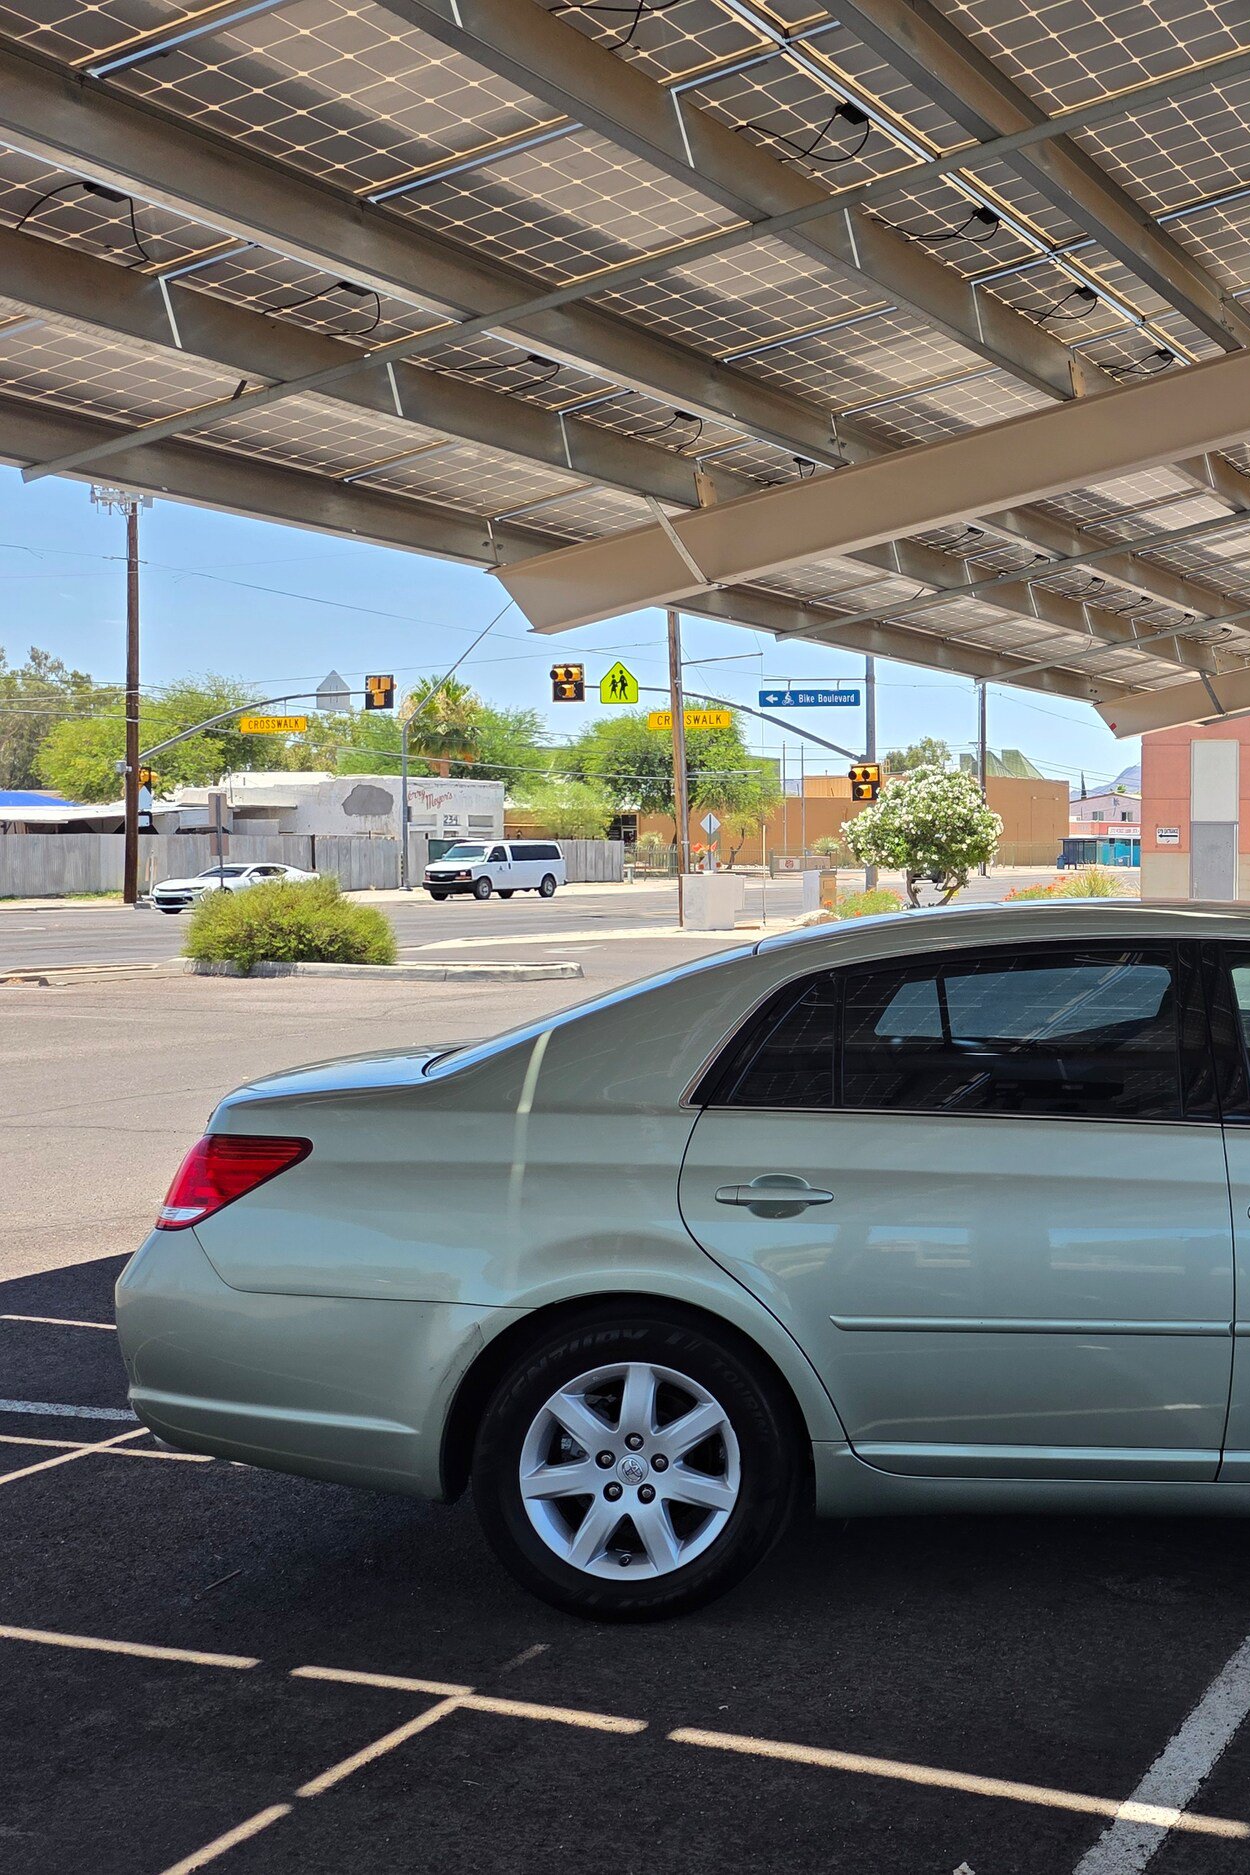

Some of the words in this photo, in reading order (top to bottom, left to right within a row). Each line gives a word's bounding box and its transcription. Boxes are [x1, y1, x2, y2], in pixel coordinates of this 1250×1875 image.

[798, 693, 815, 703] Bike
[817, 693, 855, 703] Boulevard
[248, 718, 300, 730] CROSSWALK
[657, 714, 722, 726] CRSWALK
[408, 790, 425, 801] erry
[444, 814, 458, 825] 234
